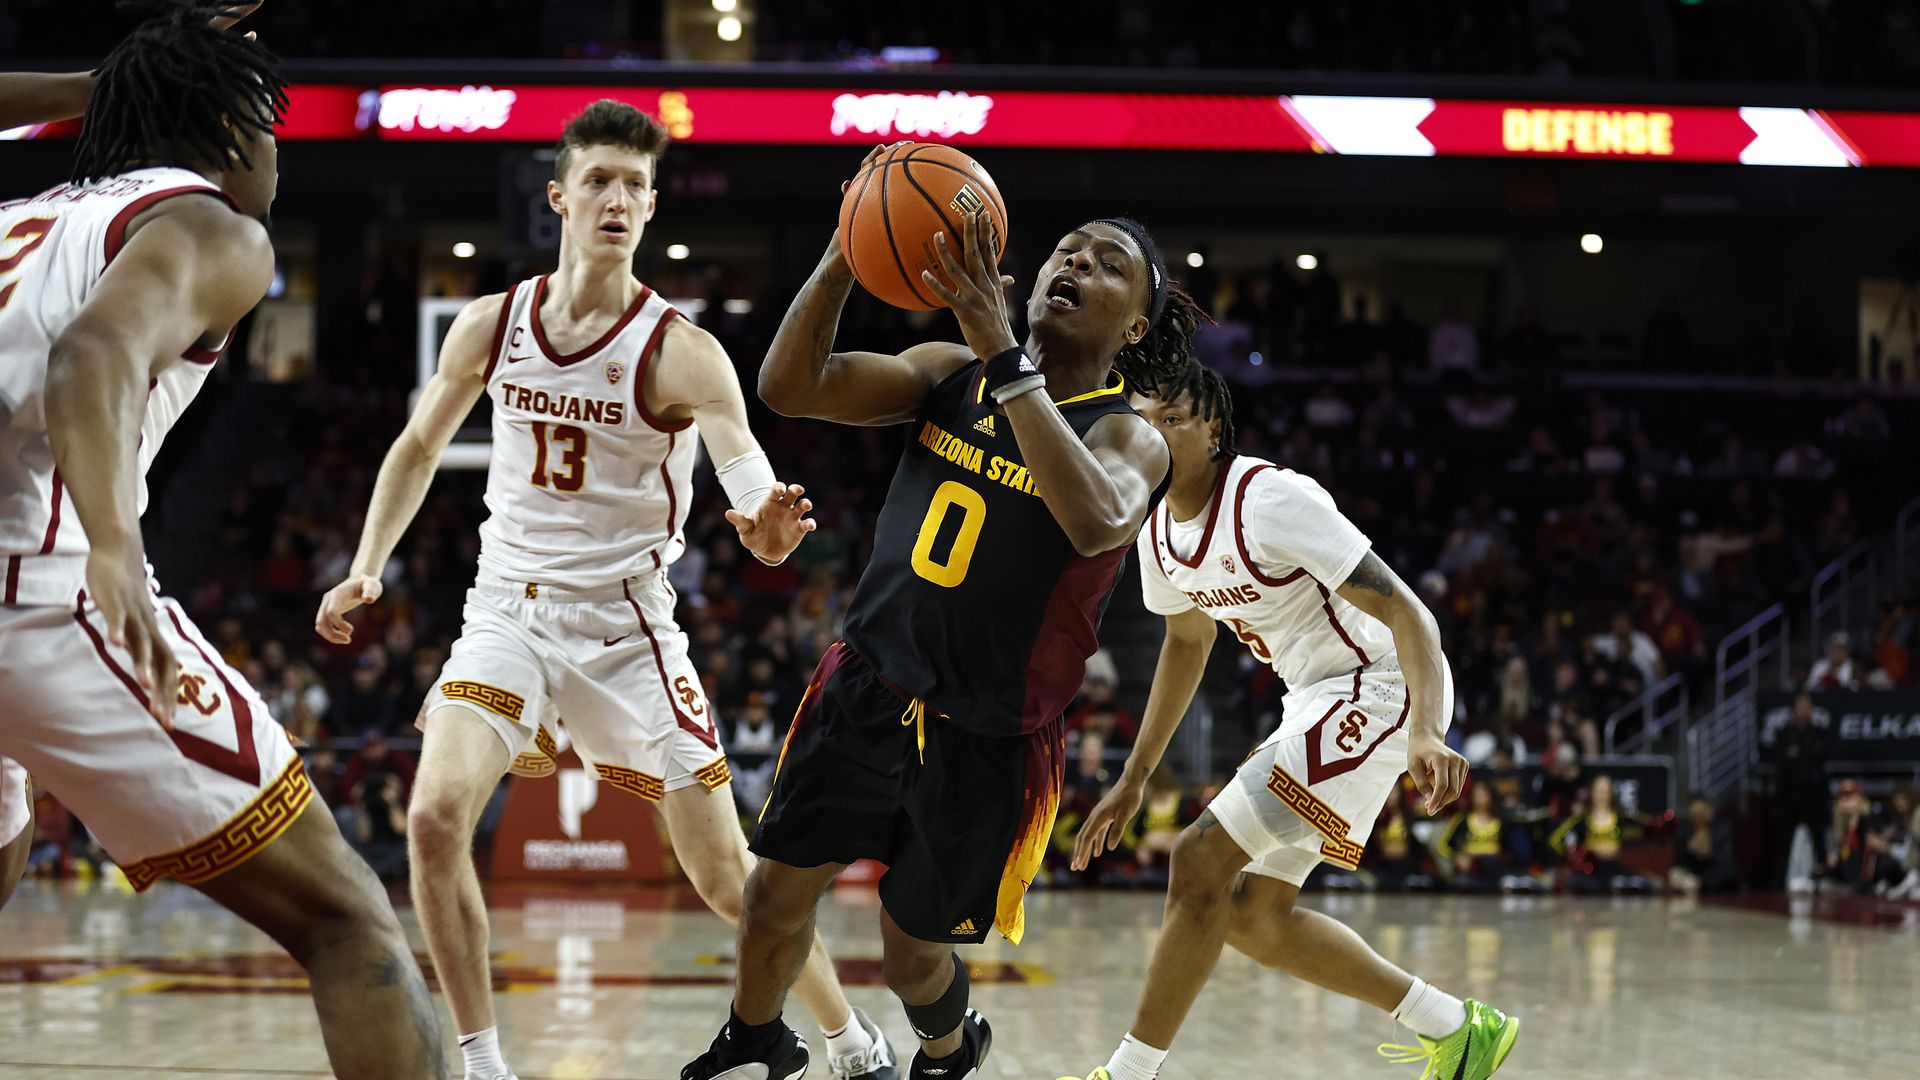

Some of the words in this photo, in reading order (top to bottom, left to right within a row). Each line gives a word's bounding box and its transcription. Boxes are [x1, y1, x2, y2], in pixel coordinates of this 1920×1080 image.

[1503, 109, 1674, 155] DEFENSE
[510, 326, 525, 349] C
[502, 383, 625, 425] TROJANS
[918, 420, 985, 475] ARIZONA
[972, 423, 997, 438] adidas
[531, 420, 589, 492] 13
[911, 480, 987, 588] 0
[1186, 583, 1262, 609] ROJANS
[1335, 709, 1368, 753] SC
